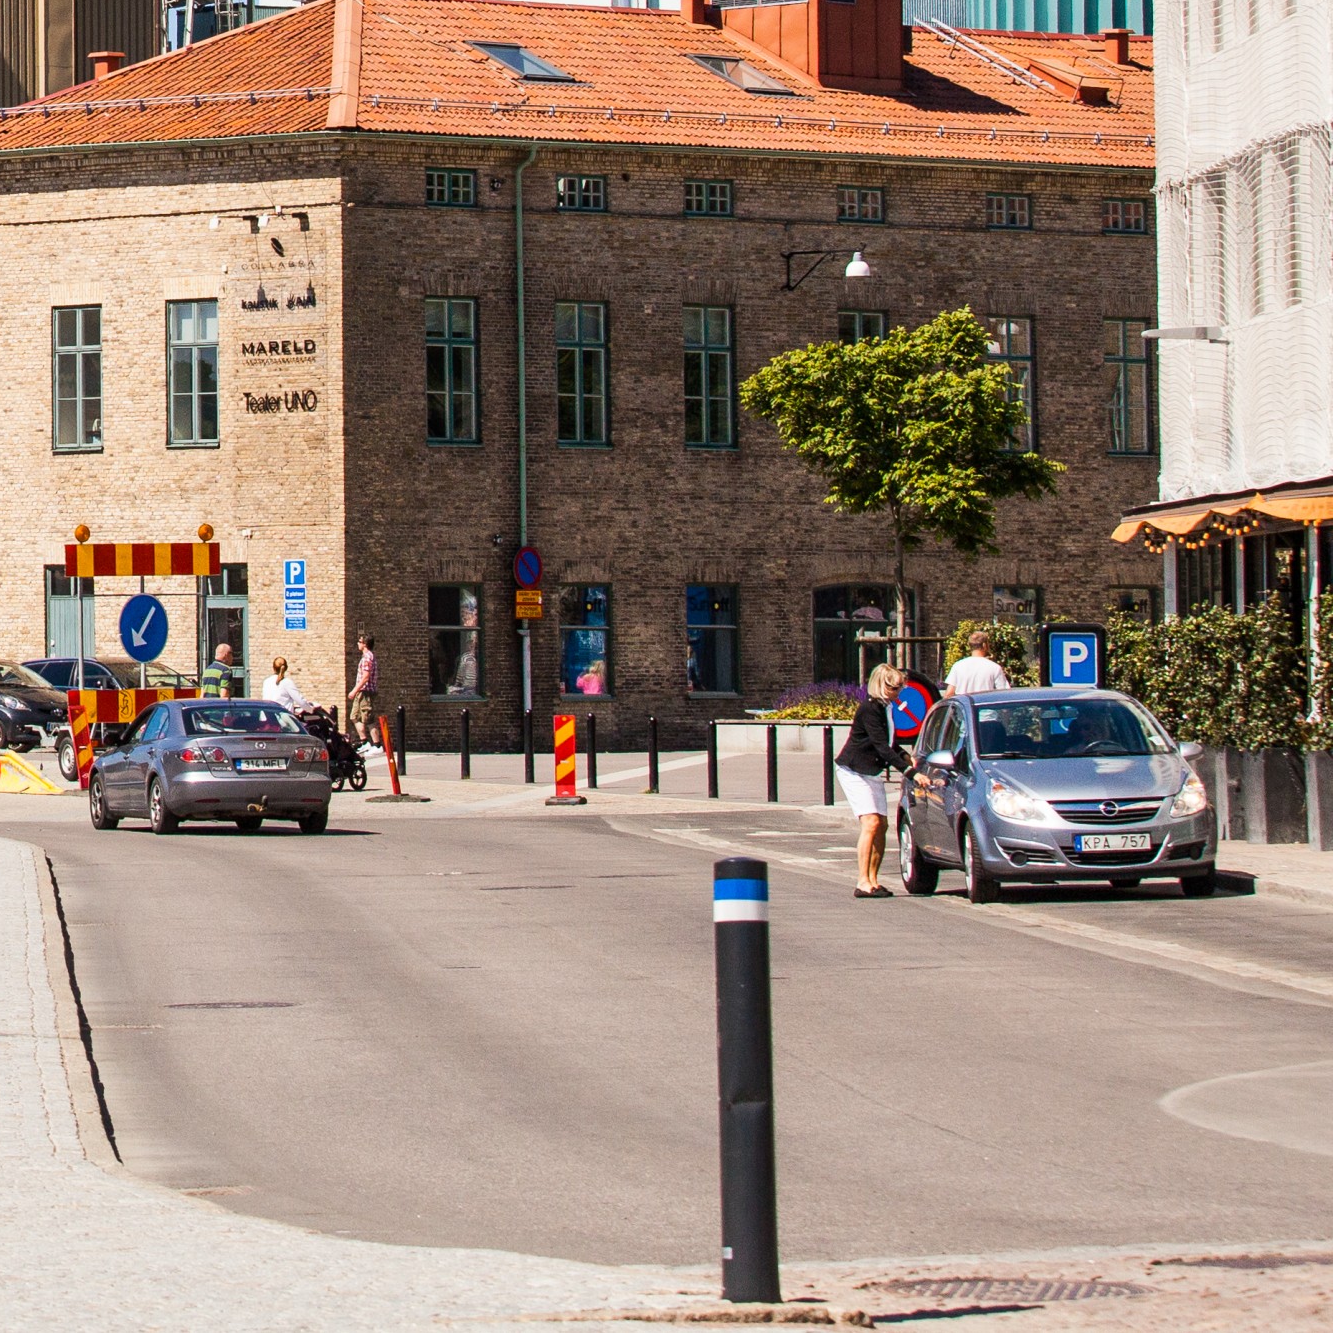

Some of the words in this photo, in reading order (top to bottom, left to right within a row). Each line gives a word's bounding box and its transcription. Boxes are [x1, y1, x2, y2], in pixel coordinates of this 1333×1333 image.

[241, 339, 316, 356] MARELD
[243, 392, 282, 414] Teater
[284, 390, 318, 413] UNO
[290, 562, 301, 584] P
[1063, 641, 1088, 678] P
[1083, 836, 1111, 849] KPA
[1120, 835, 1147, 848] 757
